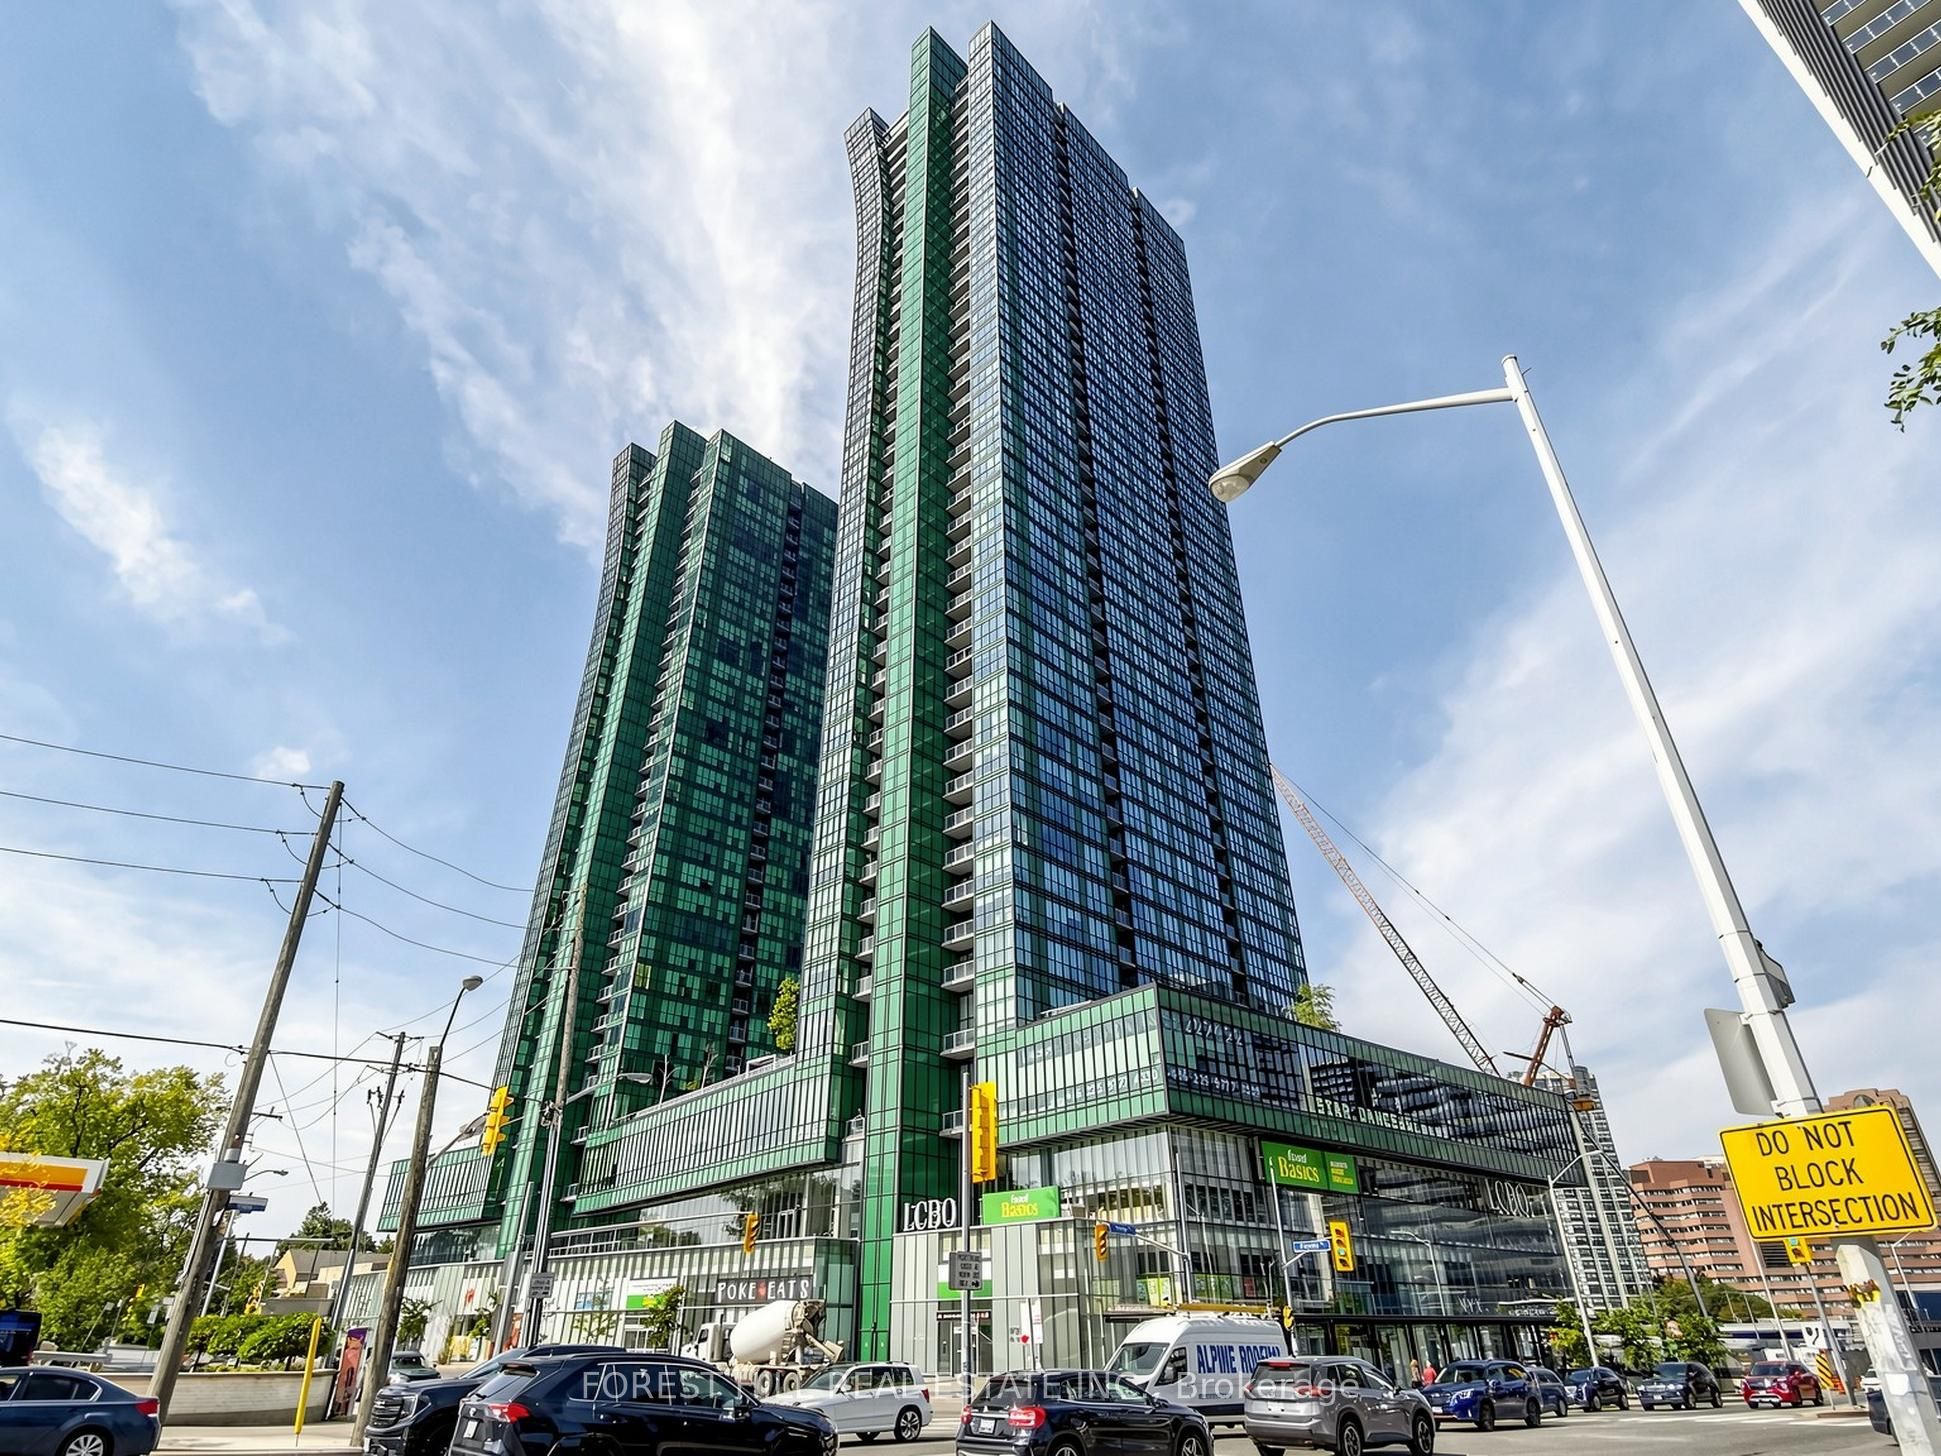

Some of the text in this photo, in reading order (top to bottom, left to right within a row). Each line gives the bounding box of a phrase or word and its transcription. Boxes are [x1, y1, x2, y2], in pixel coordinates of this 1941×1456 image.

[1756, 1121, 1855, 1157] DO NOT
[1278, 1156, 1320, 1182] Basics
[1775, 1158, 1864, 1191] BLOCK
[903, 1197, 957, 1232] LCBO
[1752, 1192, 1920, 1232] INTERSECTION
[717, 1279, 809, 1303] POKE EATS
[1196, 1344, 1237, 1374] ALPINE
